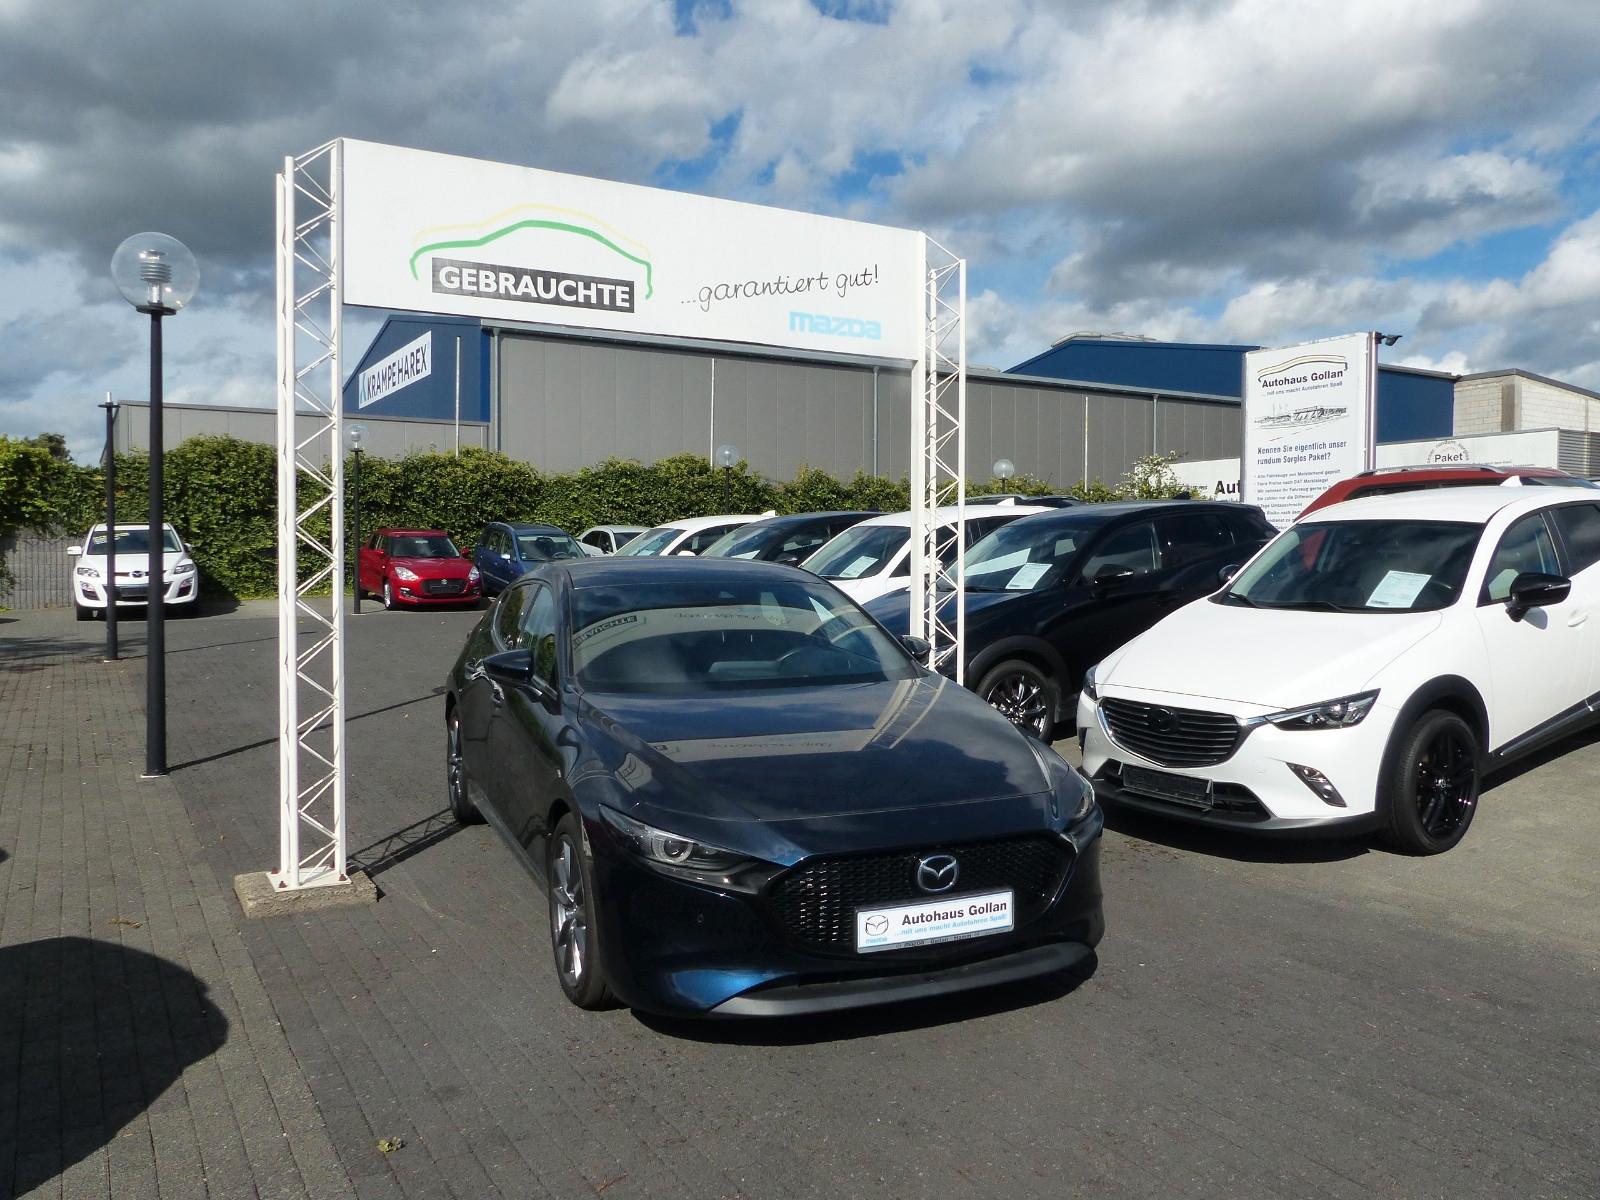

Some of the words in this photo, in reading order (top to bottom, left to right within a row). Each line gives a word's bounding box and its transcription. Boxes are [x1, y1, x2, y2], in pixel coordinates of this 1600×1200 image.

[439, 266, 630, 307] GEBRAUCHTE
[836, 264, 879, 298] gut!
[1262, 375, 1308, 388] Autohaus
[1311, 370, 1343, 381] Gollan
[1283, 445, 1293, 453] Sie
[1294, 442, 1327, 453] eigentlich
[1328, 441, 1347, 449] unser
[1257, 457, 1282, 465] rundum
[1283, 455, 1307, 464] Sorglos
[1308, 452, 1331, 462] Paket?
[1434, 452, 1463, 463] Paket
[901, 909, 964, 926] Autohaus
[968, 902, 1007, 917] Gollan
[929, 923, 951, 932] macht
[952, 917, 989, 929] Autofahren
